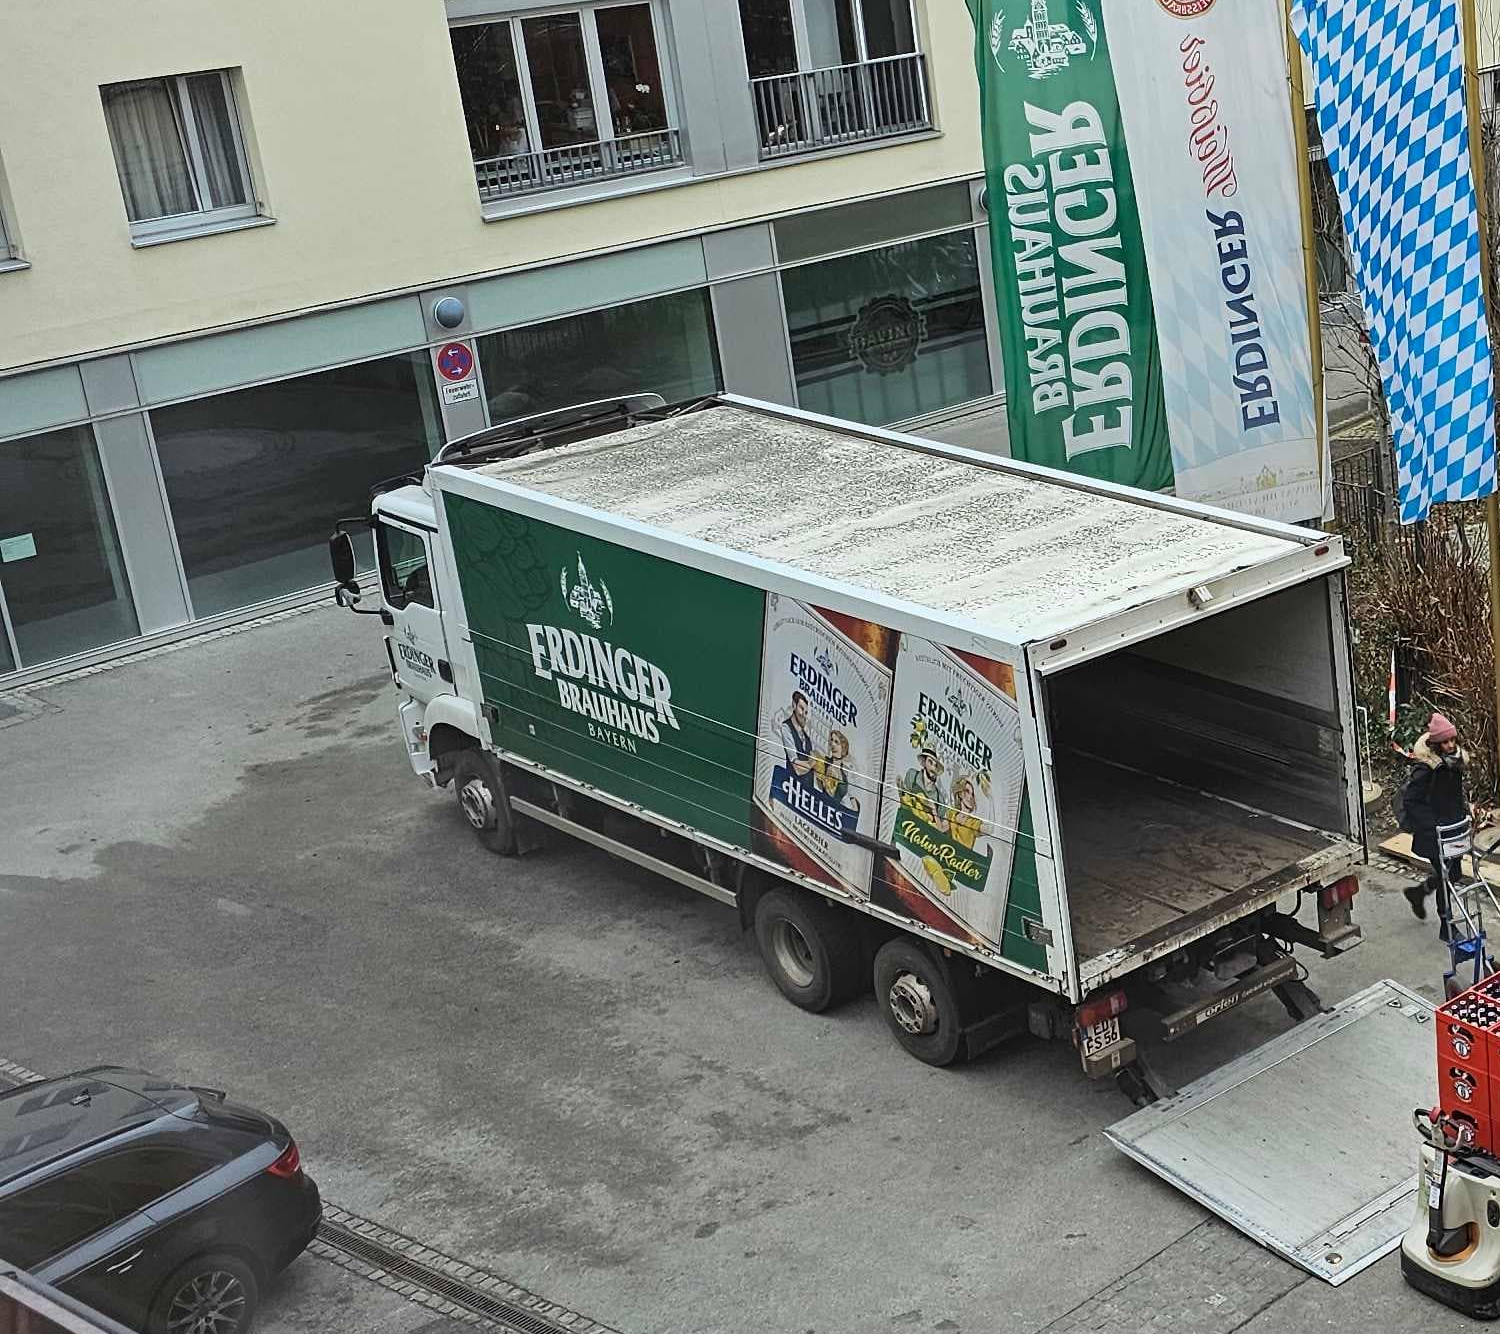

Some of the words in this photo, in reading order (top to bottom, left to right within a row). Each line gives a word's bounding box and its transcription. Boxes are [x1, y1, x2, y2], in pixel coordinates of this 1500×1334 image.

[526, 623, 680, 731] ERDINGER
[790, 652, 858, 727] ERDINGER
[799, 677, 847, 727] BRAUHAUS
[556, 678, 660, 744] BRAUHAUS
[918, 691, 993, 771] ERDINGER
[587, 722, 637, 754] BAYERN
[928, 718, 981, 770] BRAUHAUS
[782, 775, 843, 830] HELLES
[1086, 1036, 1103, 1054] FS
[1093, 1018, 1110, 1036] ED
